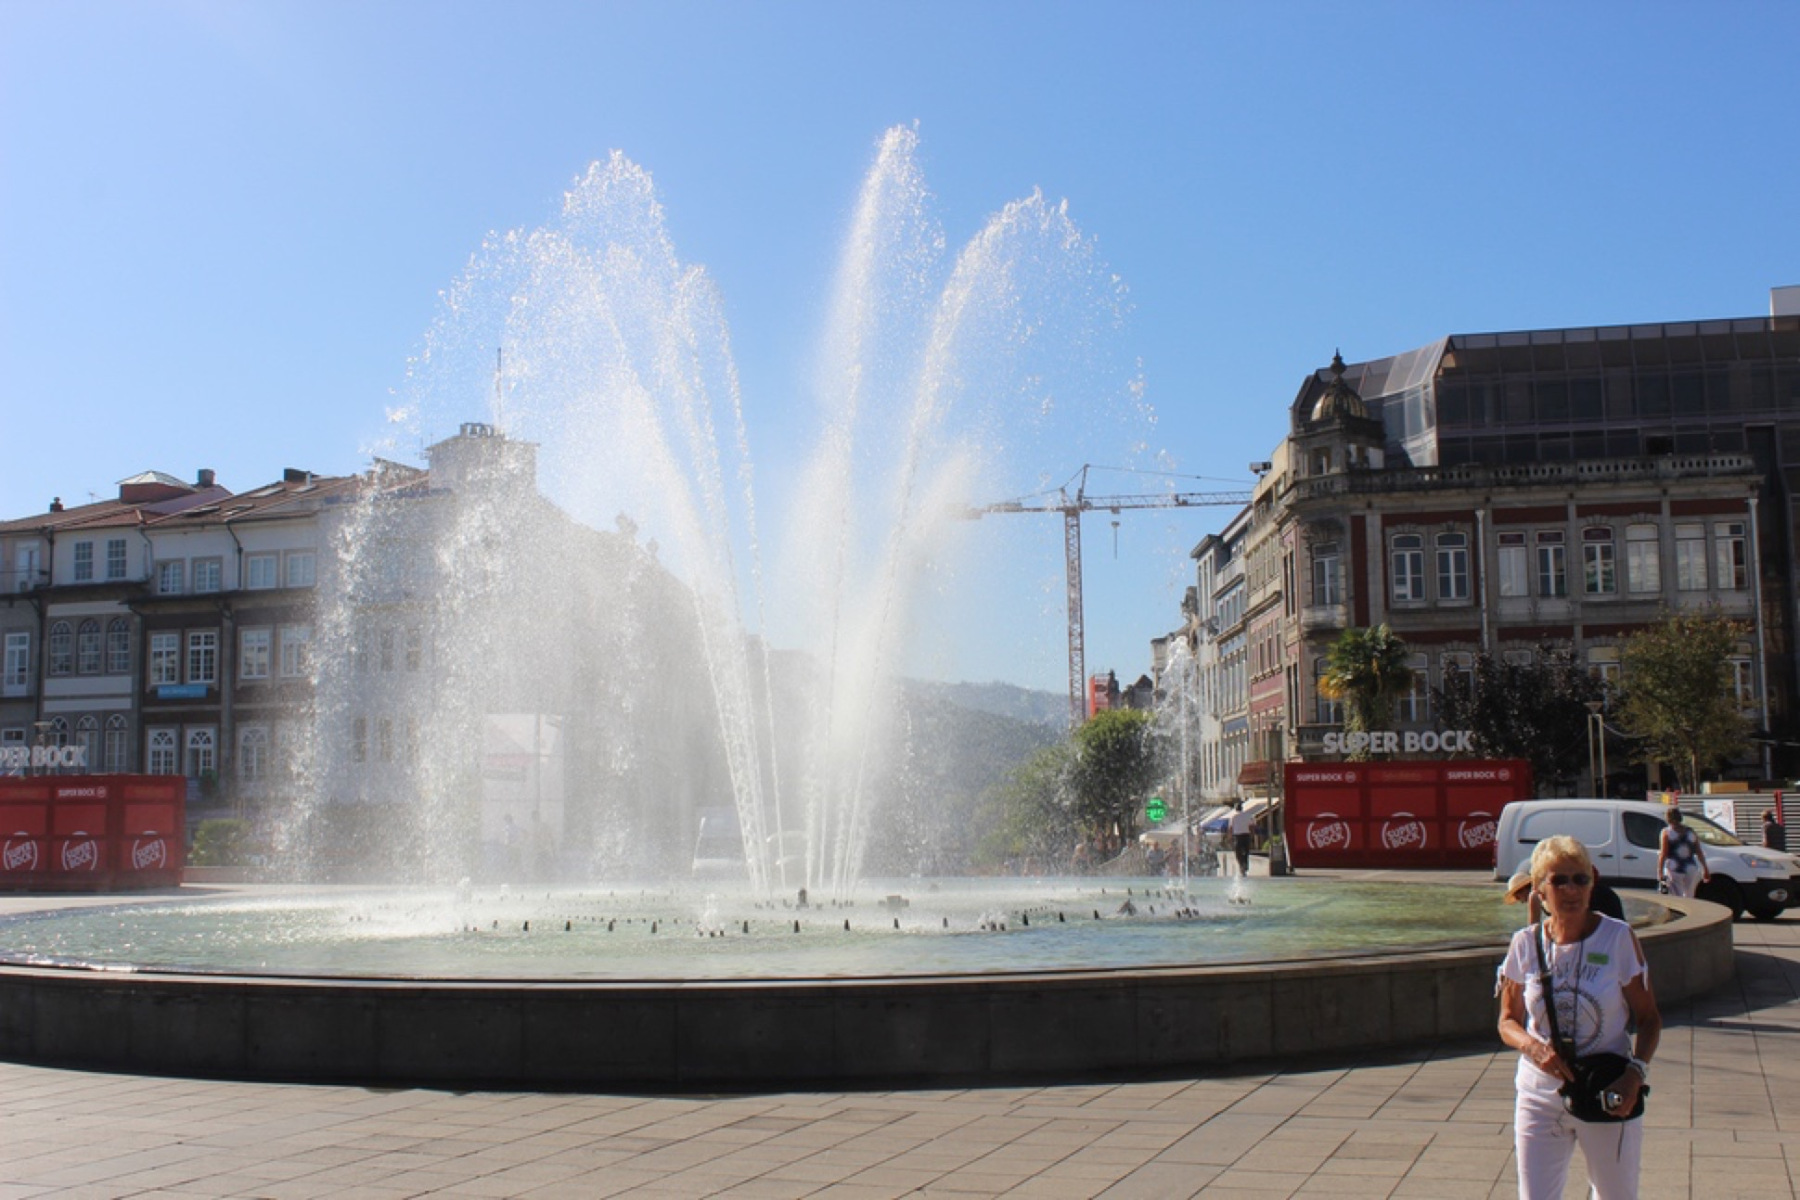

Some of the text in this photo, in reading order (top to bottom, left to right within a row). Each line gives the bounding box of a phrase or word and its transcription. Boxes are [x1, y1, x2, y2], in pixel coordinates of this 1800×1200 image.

[1323, 730, 1474, 754] SUPER BOCK
[32, 745, 87, 767] BOCK
[1297, 773, 1319, 781] SUPER
[1320, 773, 1342, 781] BOCK
[1447, 771, 1472, 779] SUPER
[1473, 771, 1496, 779] BOCK
[58, 788, 77, 797] SUPER
[77, 787, 96, 797] BOCK
